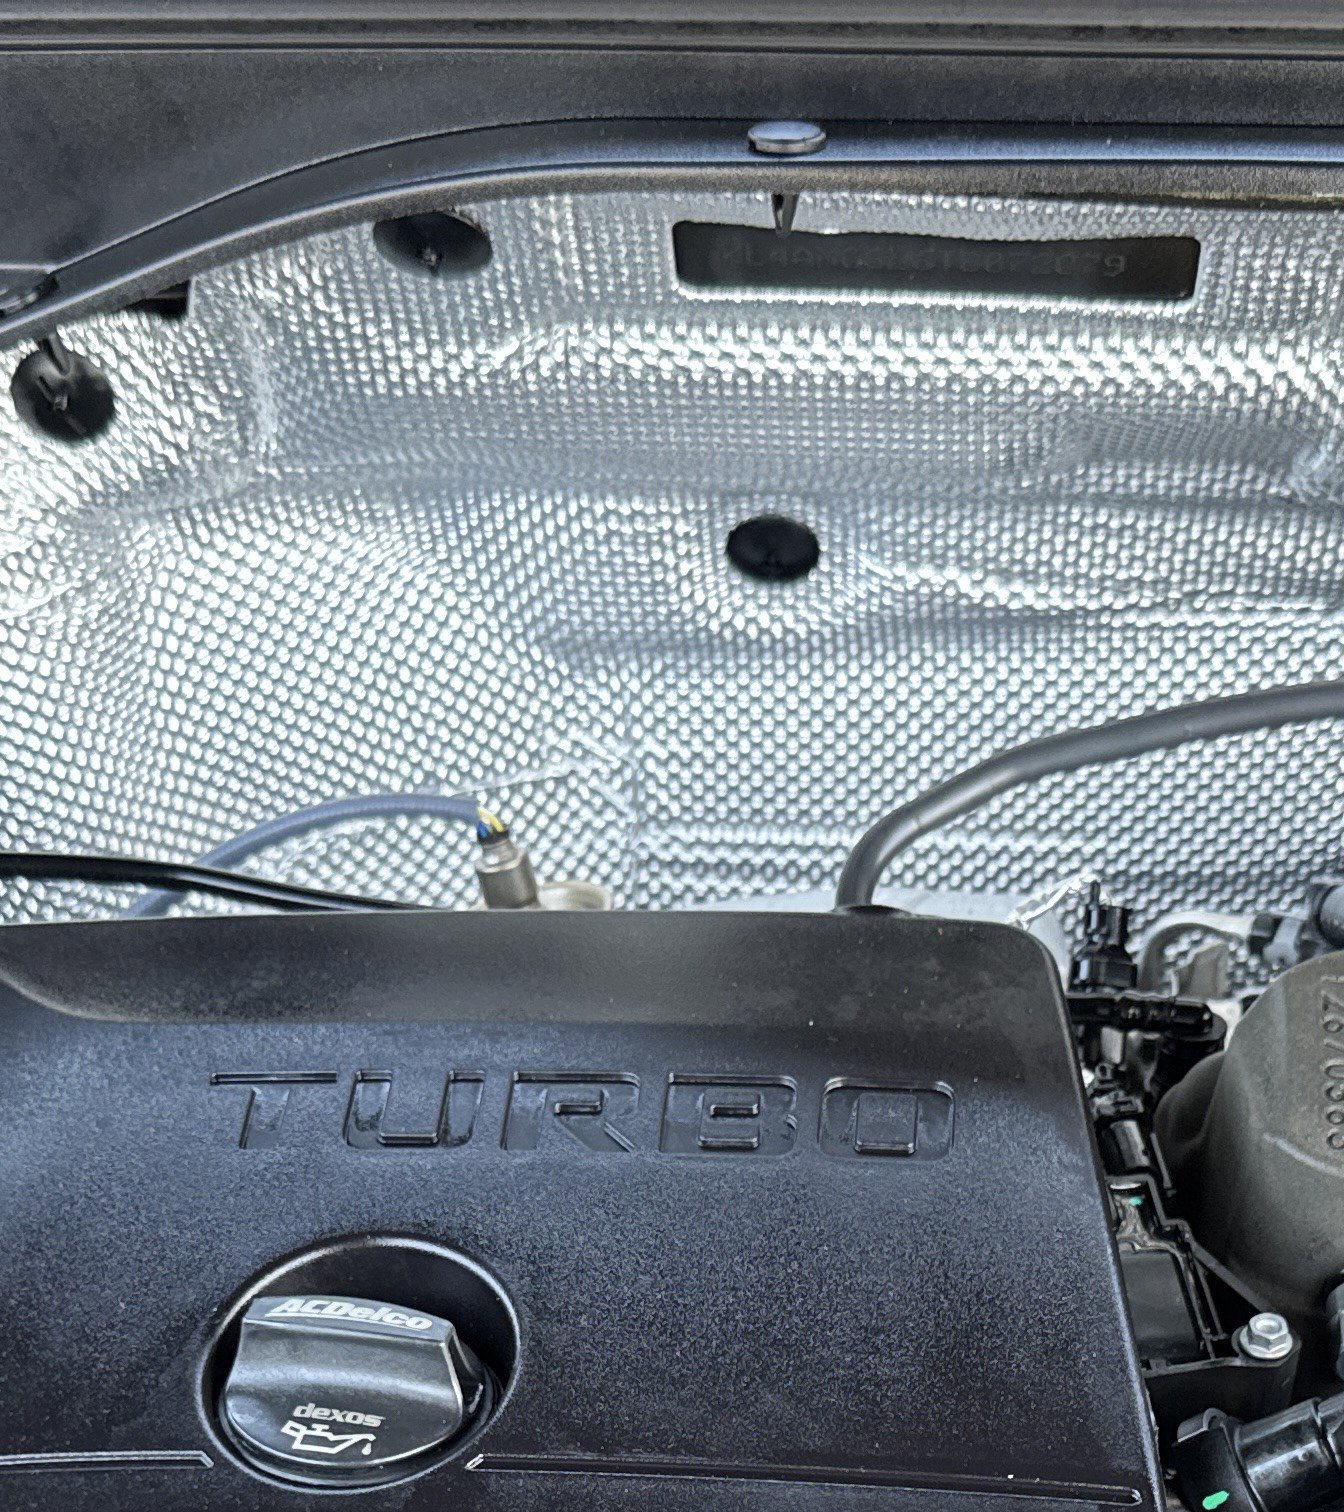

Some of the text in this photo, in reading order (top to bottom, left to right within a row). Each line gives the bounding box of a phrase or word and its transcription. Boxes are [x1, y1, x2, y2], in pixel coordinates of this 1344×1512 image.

[210, 1069, 957, 1157] TURBO
[270, 1298, 433, 1330] ACDelco
[292, 1402, 386, 1428] dexos
